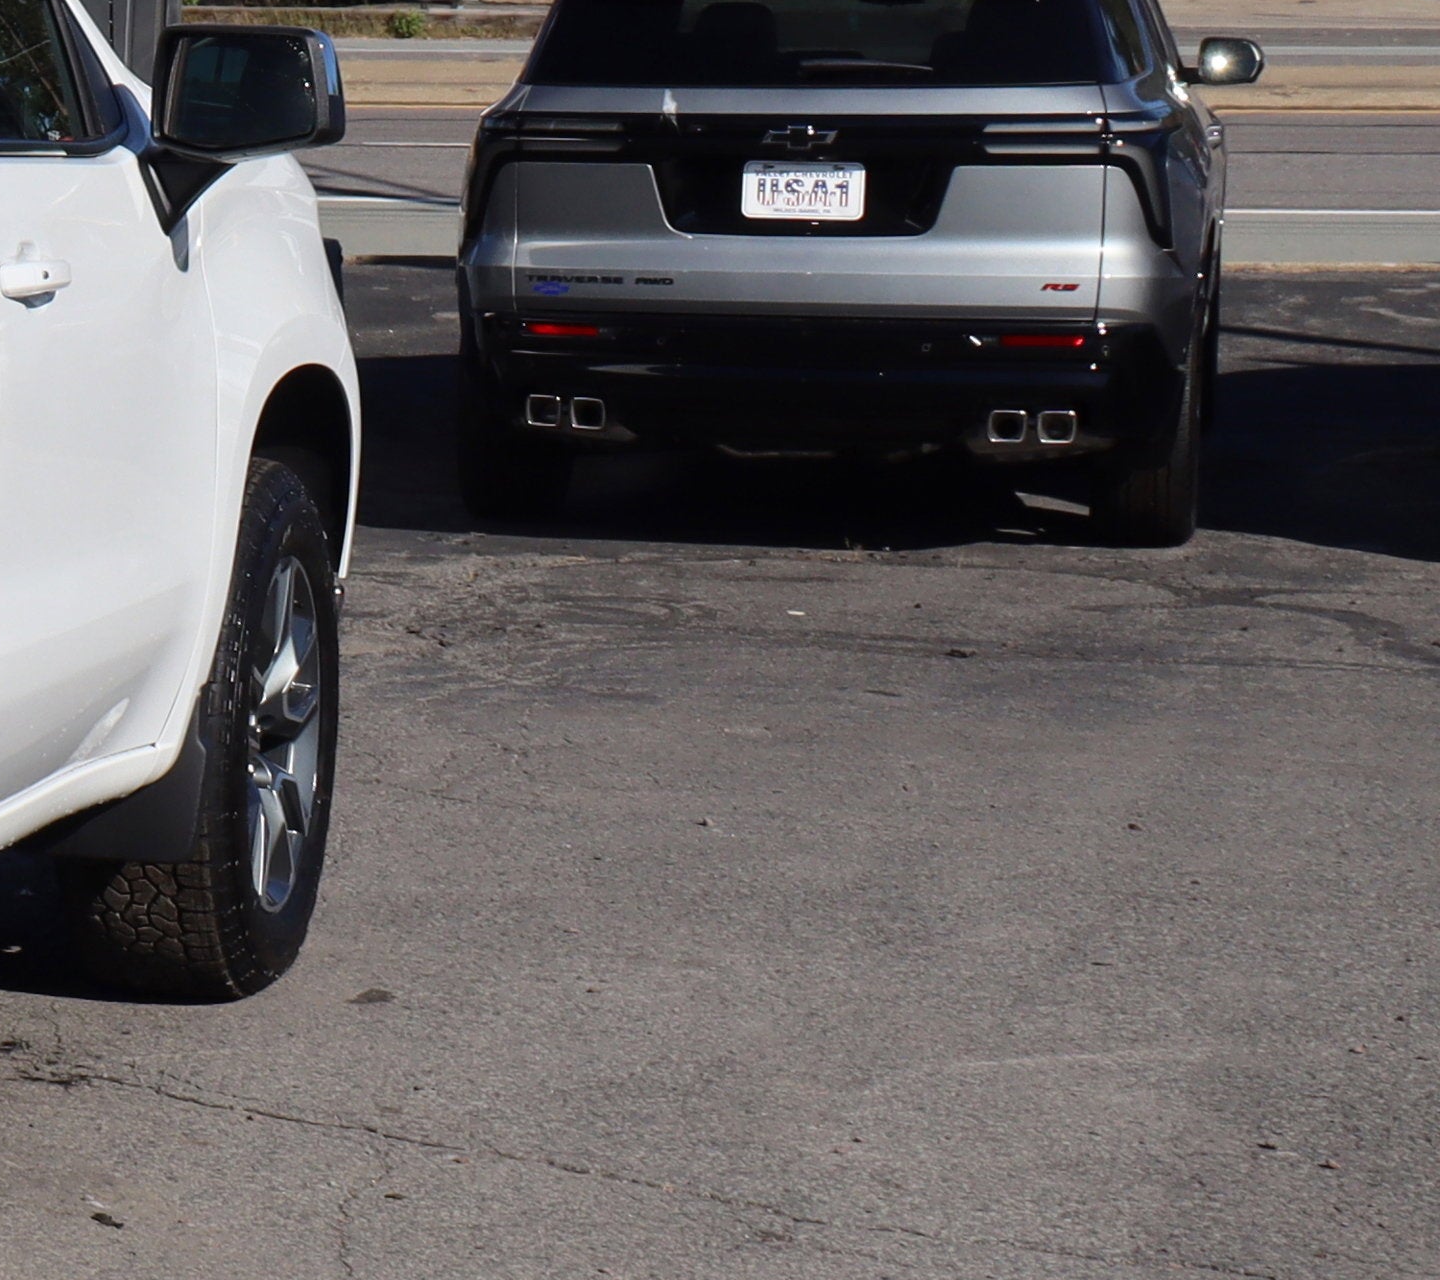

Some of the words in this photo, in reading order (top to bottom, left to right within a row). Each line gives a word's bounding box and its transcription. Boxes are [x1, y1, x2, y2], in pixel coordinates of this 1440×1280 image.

[795, 171, 853, 179] CHEVROLET
[527, 274, 623, 284] TRAVERSE
[634, 276, 674, 285] AWD
